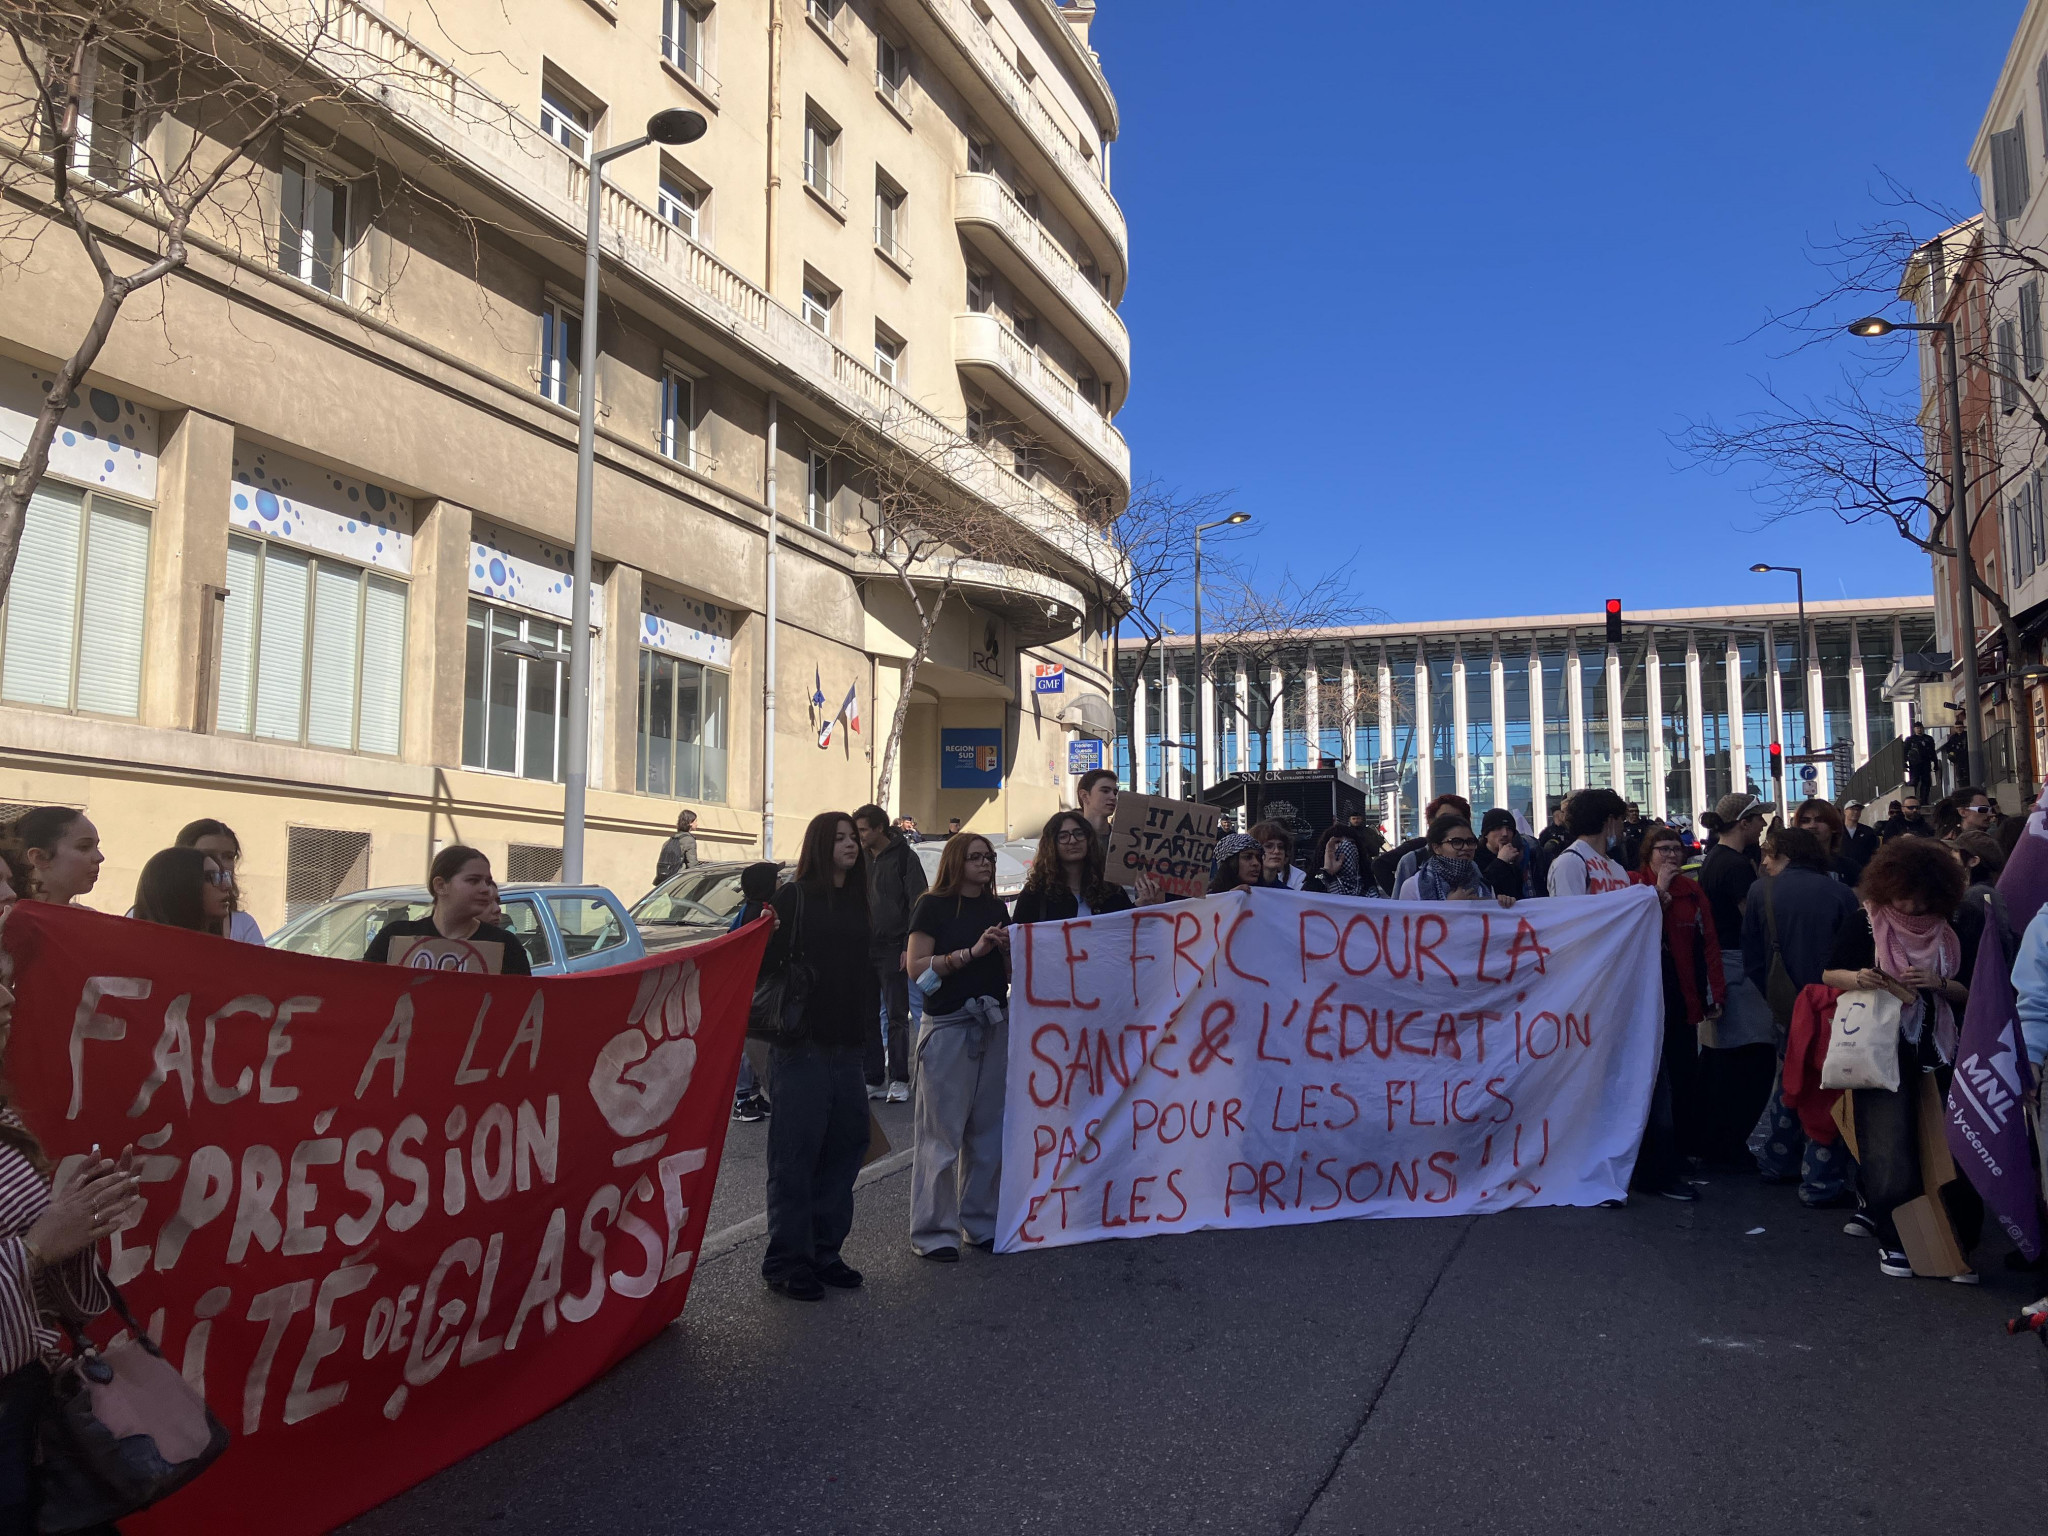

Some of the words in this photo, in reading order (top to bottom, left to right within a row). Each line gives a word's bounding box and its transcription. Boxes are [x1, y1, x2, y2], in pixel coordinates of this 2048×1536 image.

[1038, 679, 1061, 690] GMF
[1127, 827, 1215, 863] STARTED
[1146, 807, 1173, 829] IT
[1175, 812, 1216, 838] ALL
[1023, 921, 1101, 1010] LE
[1131, 908, 1271, 1007] FRIC
[1300, 909, 1459, 987] POUR
[1475, 913, 1551, 984] LA
[66, 976, 323, 1120] FACE
[454, 989, 545, 1086] LA
[1188, 998, 1235, 1075] &
[1962, 1053, 2015, 1124] MNL
[1032, 1118, 1101, 1181] PAS
[1131, 1097, 1246, 1151] POUR
[1271, 1082, 1361, 1133] LES
[1385, 1076, 1515, 1132] FLICS
[1953, 1107, 2003, 1177] lycéenne
[1019, 1185, 1080, 1243] ET
[1101, 1167, 1188, 1228] LES
[362, 1285, 420, 1361] DE
